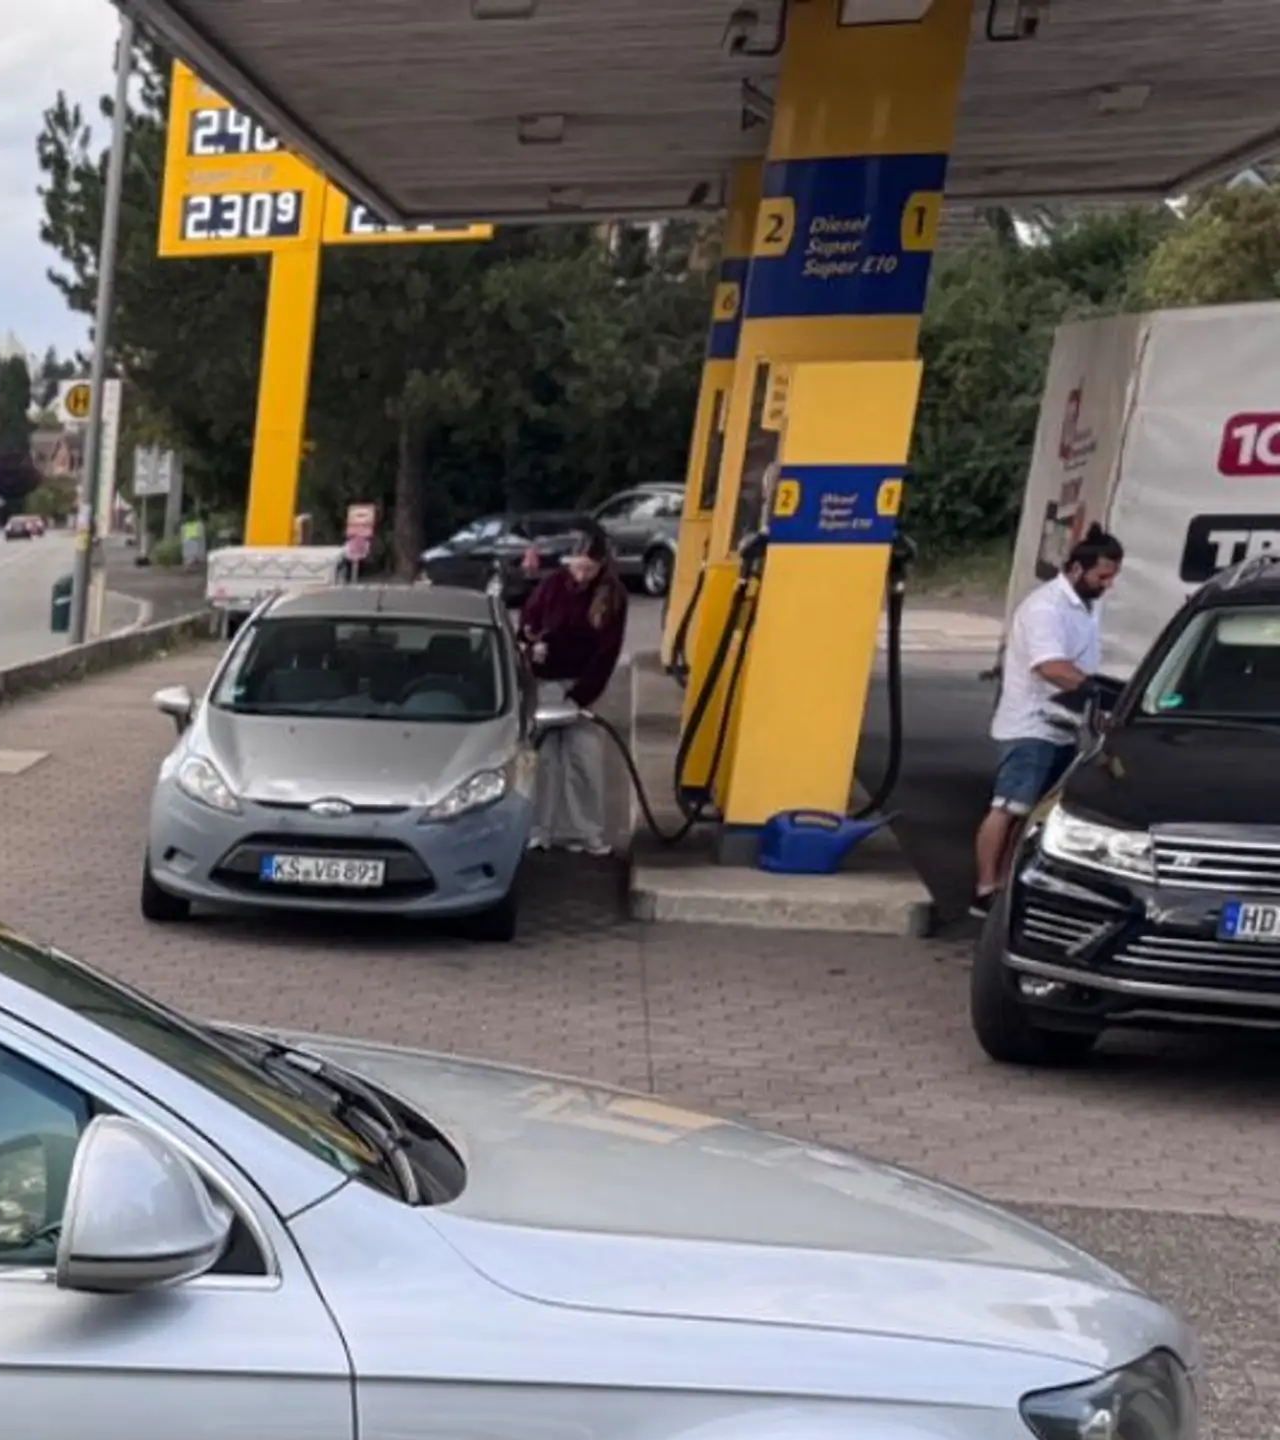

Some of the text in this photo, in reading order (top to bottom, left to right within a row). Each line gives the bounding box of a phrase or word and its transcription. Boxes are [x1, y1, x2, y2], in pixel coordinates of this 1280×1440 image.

[763, 213, 785, 243] 2
[809, 213, 871, 234] Diesel
[912, 205, 927, 238] 1
[804, 237, 862, 258] Super
[801, 254, 898, 279] Super E10
[1241, 906, 1277, 932] HD
